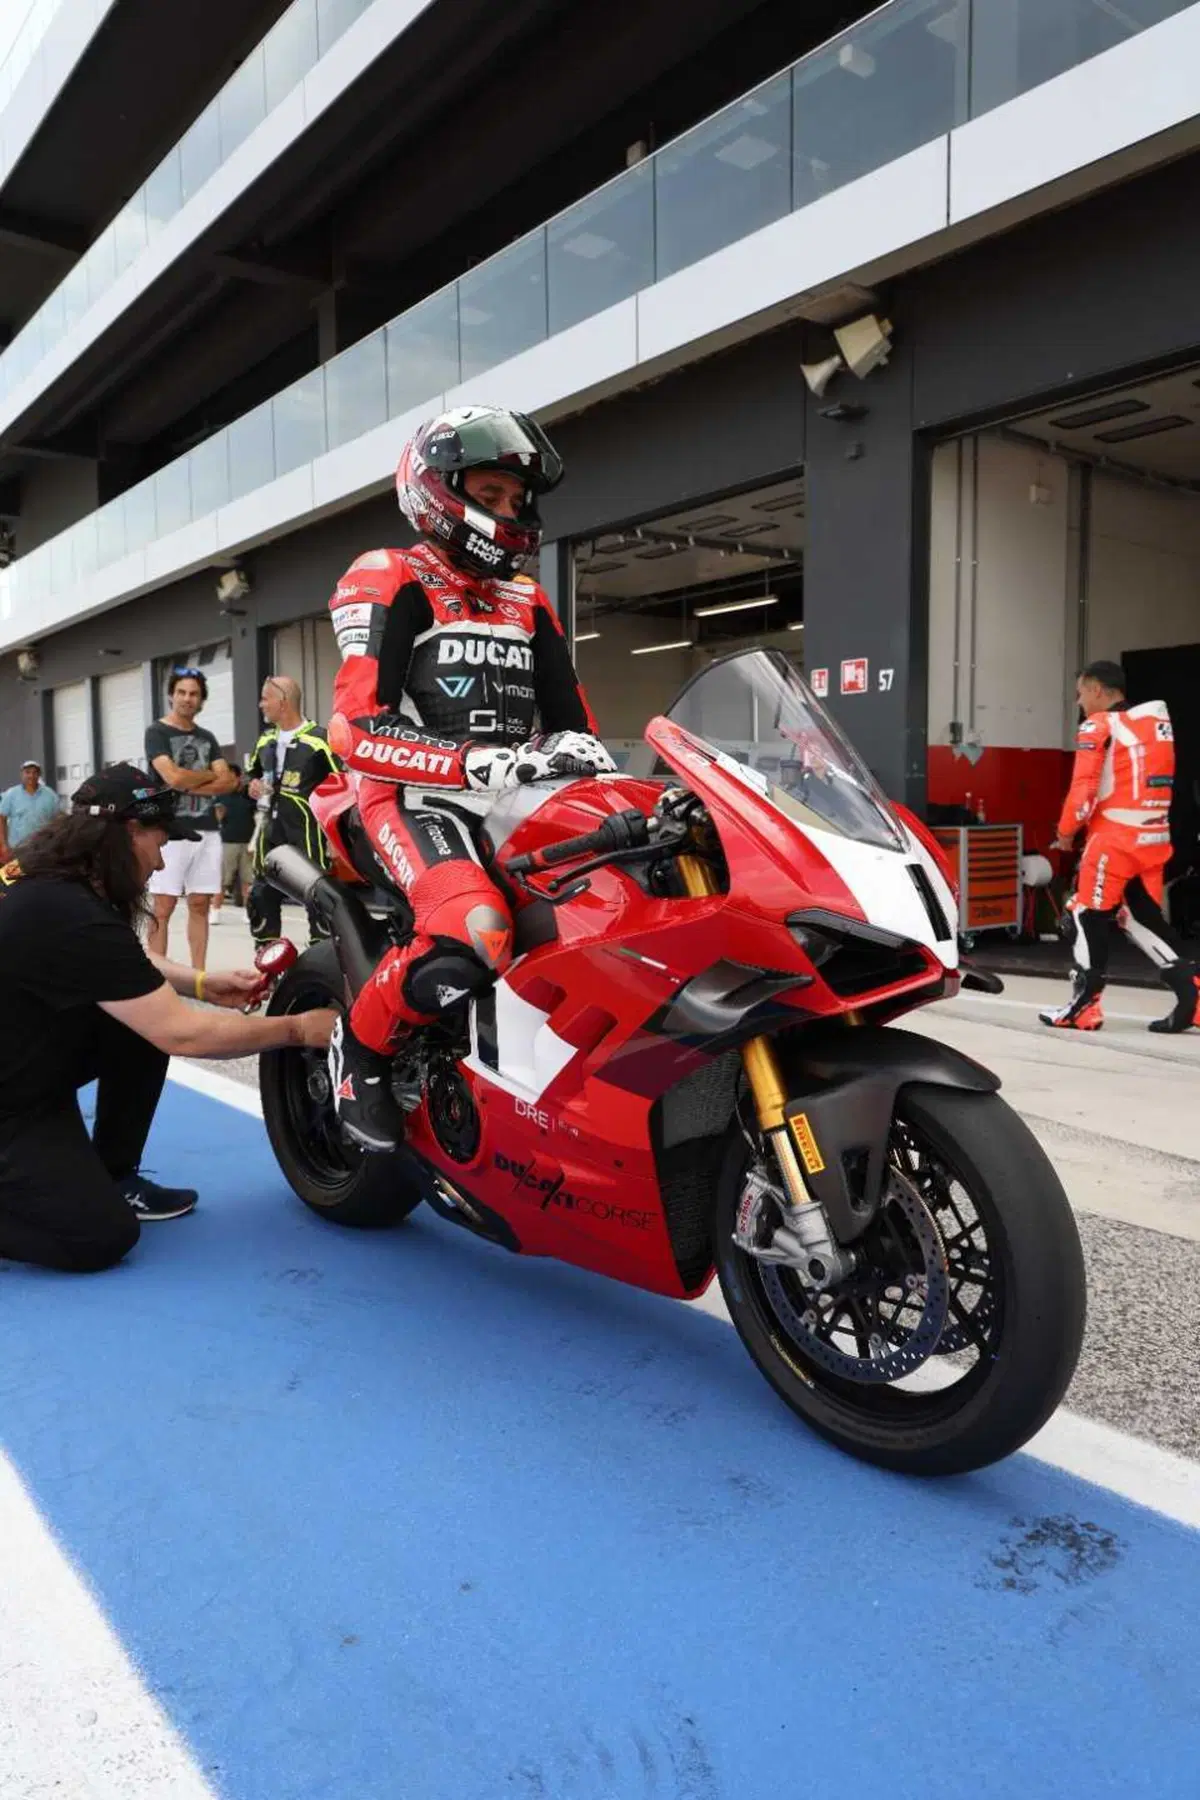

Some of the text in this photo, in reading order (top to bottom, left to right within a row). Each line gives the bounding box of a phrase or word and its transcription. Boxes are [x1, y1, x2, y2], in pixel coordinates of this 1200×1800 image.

[465, 541, 501, 565] SHOT
[469, 532, 504, 557] SNAP
[879, 668, 894, 691] 57
[354, 739, 454, 776] DUCATI
[378, 822, 415, 897] DUCATI
[514, 1098, 549, 1130] DRE
[576, 1197, 660, 1231] CORSE
